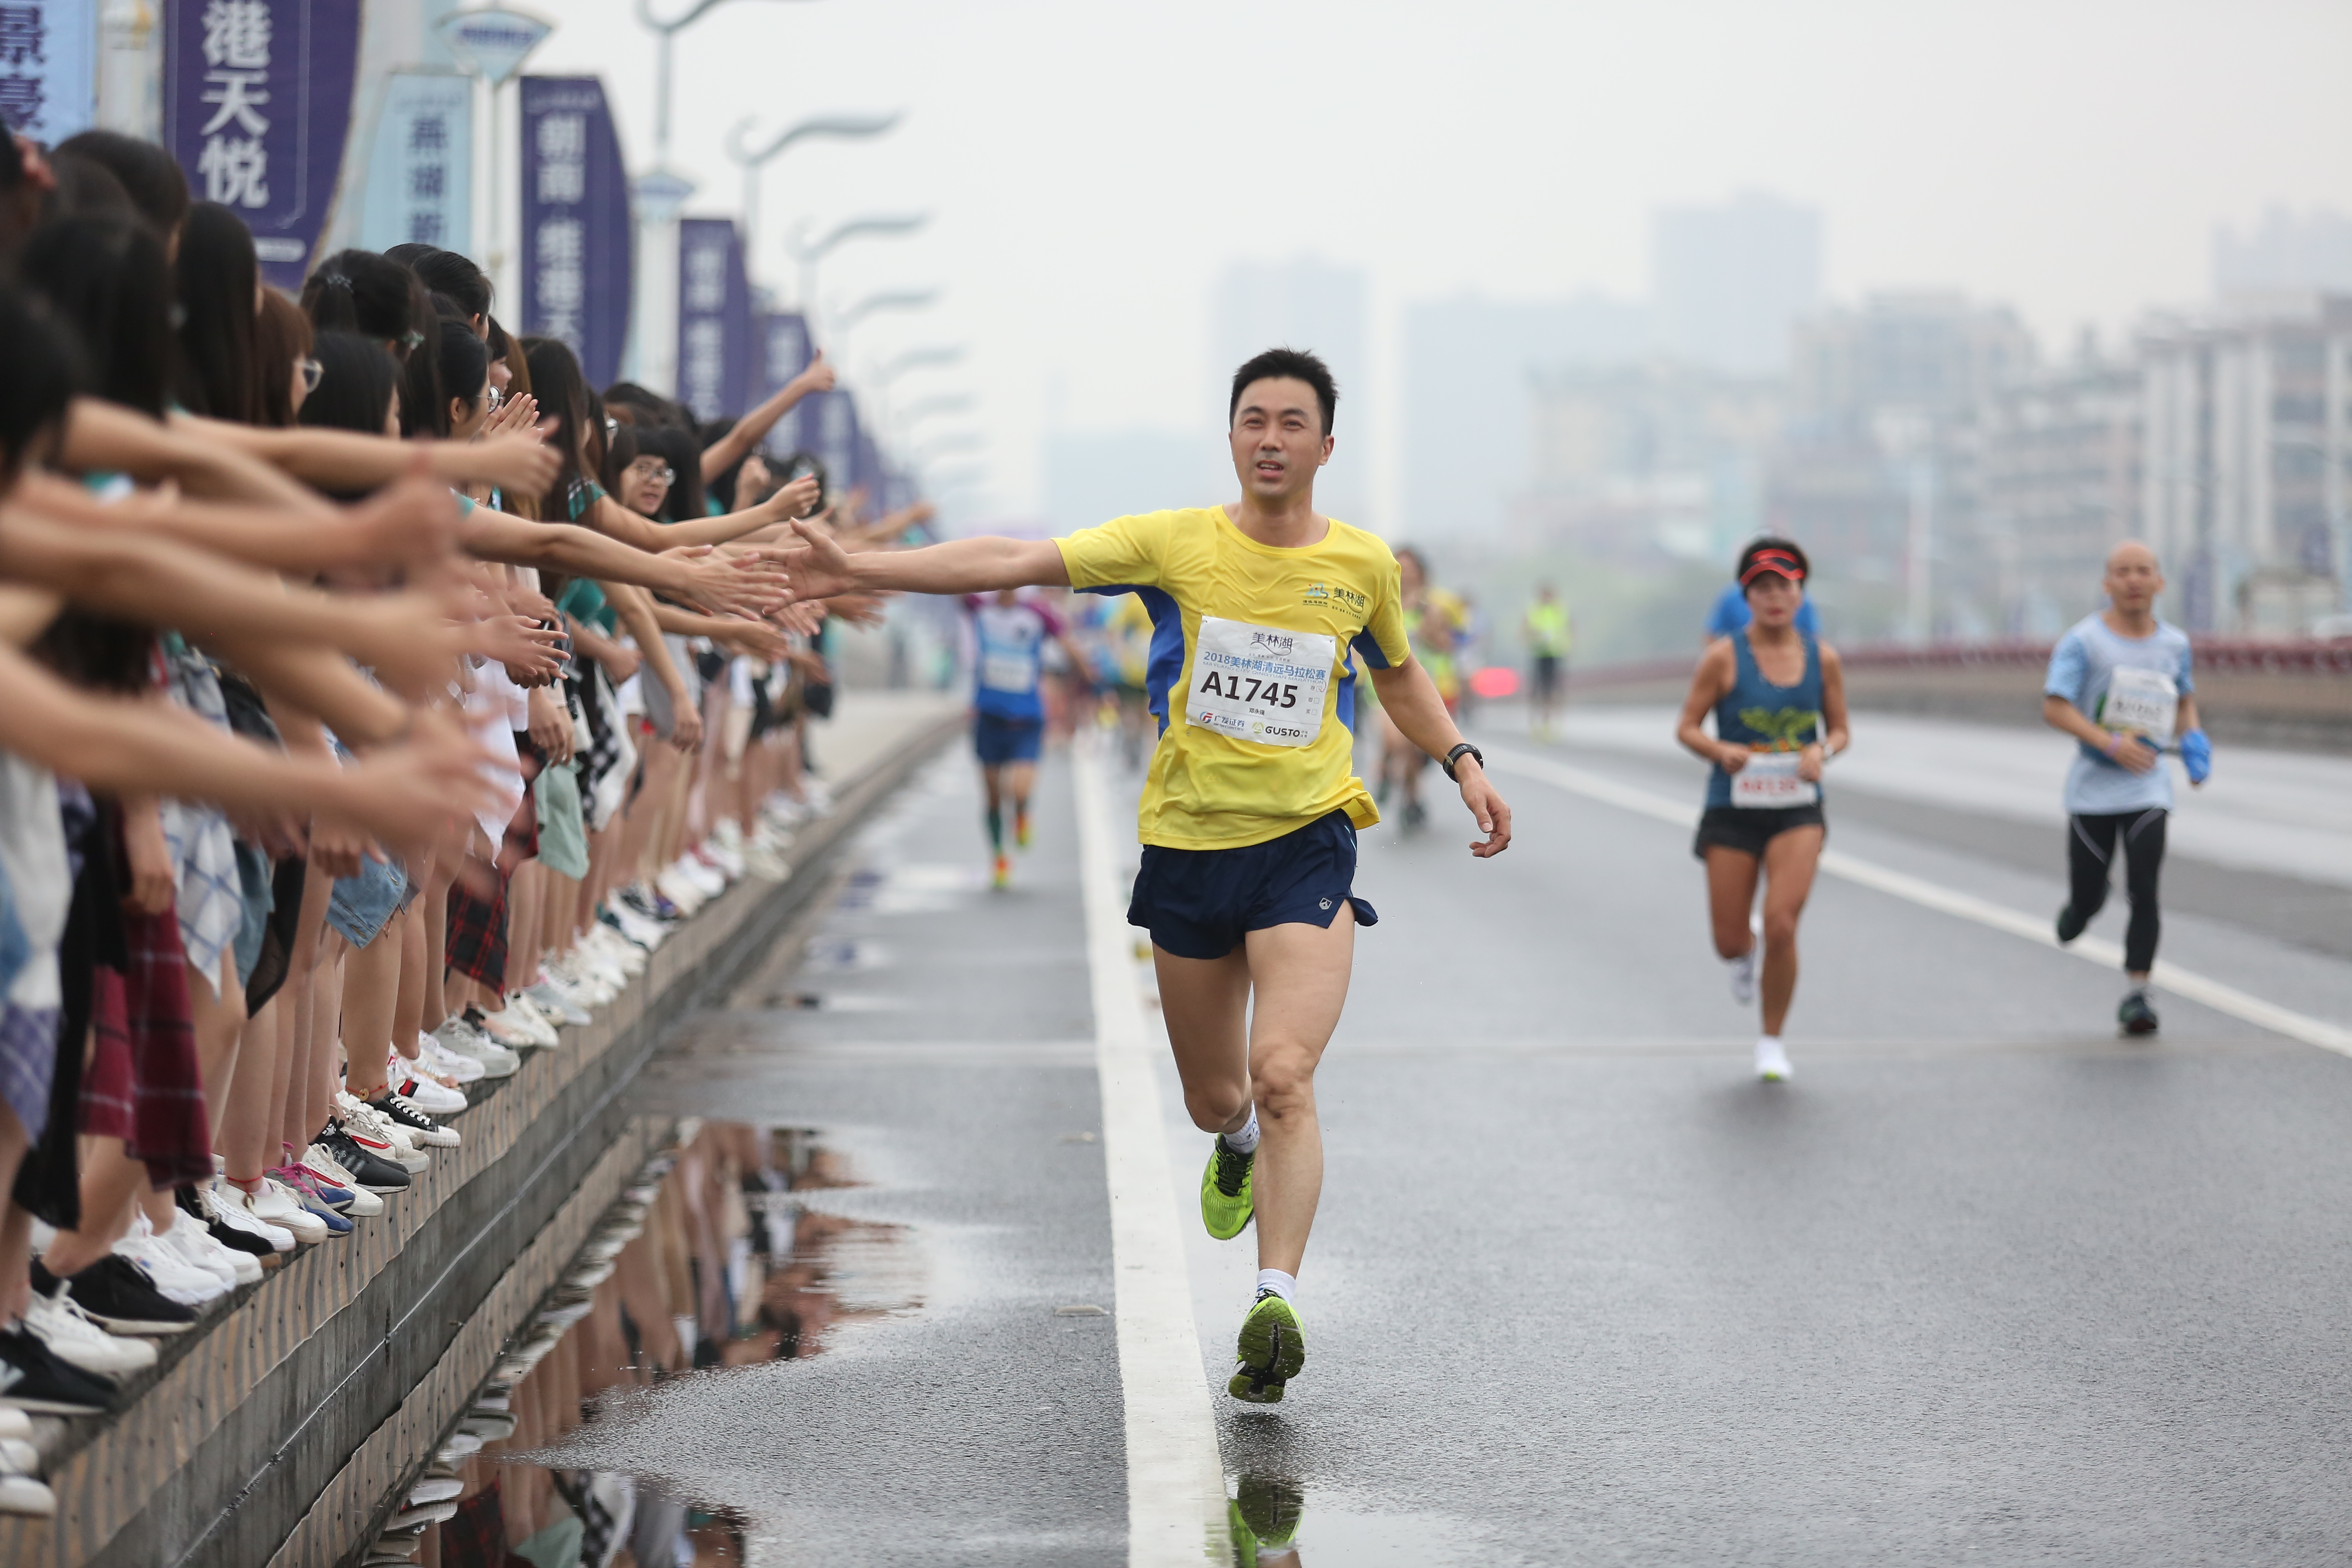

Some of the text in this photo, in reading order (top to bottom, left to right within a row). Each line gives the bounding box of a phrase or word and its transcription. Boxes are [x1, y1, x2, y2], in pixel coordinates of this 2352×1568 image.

[198, 0, 272, 209] 港天悦
[1333, 587, 1365, 607] 美林湖
[1252, 632, 1293, 649] 美林湖
[1203, 651, 1326, 681] 2018美林湖清远马拉松赛
[1203, 661, 1234, 670] MAYLAND
[1252, 671, 1287, 679] QINGYUAN
[1288, 676, 1324, 684] MARATHON
[1200, 671, 1298, 708] A1745
[1214, 715, 1245, 727] 广发证券
[1265, 726, 1300, 737] GUSTO
